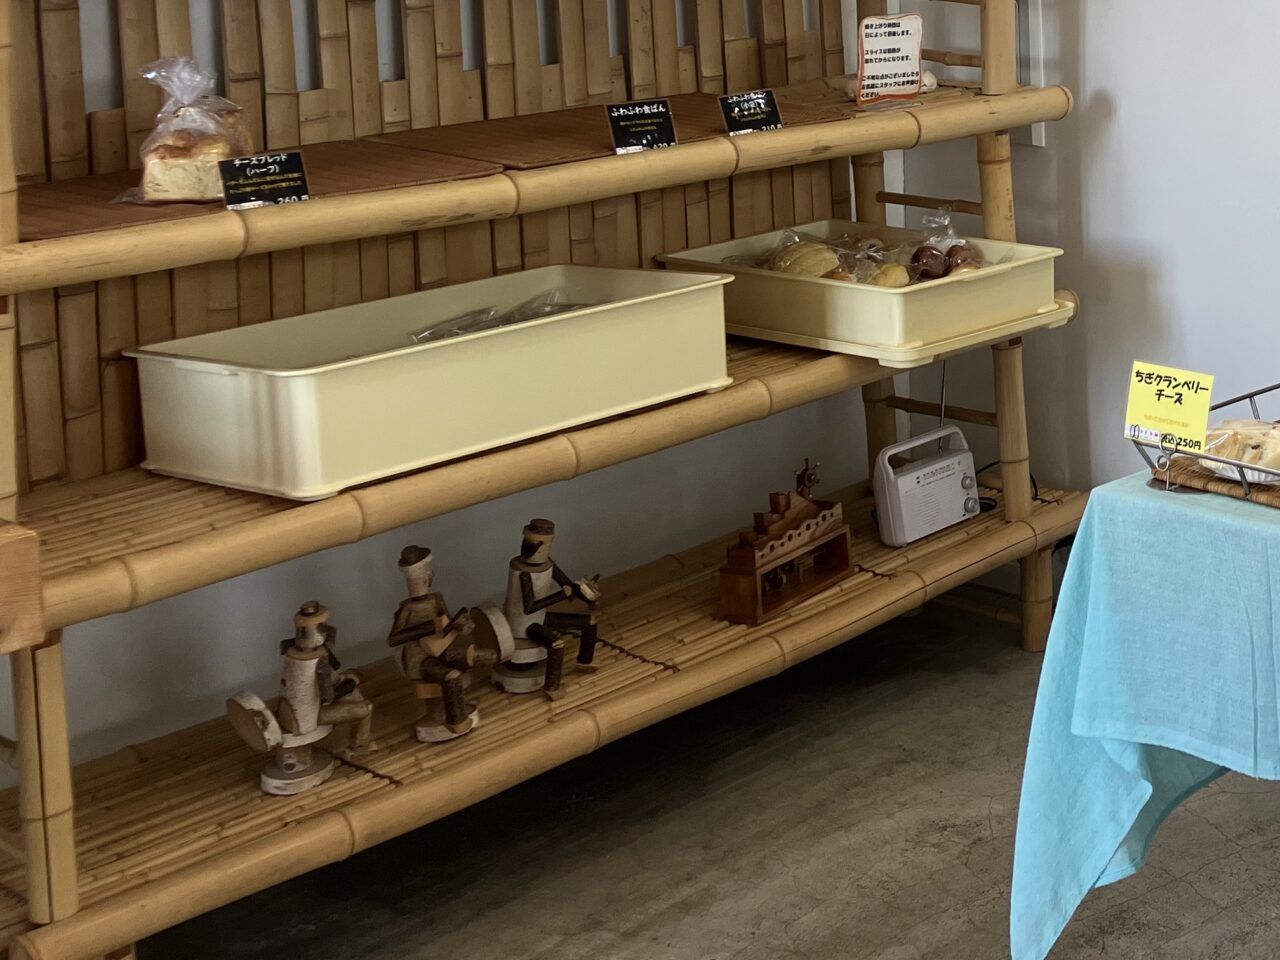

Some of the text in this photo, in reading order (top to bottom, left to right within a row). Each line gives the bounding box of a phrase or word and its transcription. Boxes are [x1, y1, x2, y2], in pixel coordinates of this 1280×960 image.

[233, 152, 288, 167] チーズブレッド
[277, 195, 298, 205] 260
[1135, 370, 1209, 394] ちぎクランベリー
[1155, 388, 1183, 406] チーズ
[1176, 436, 1202, 450] 250円
